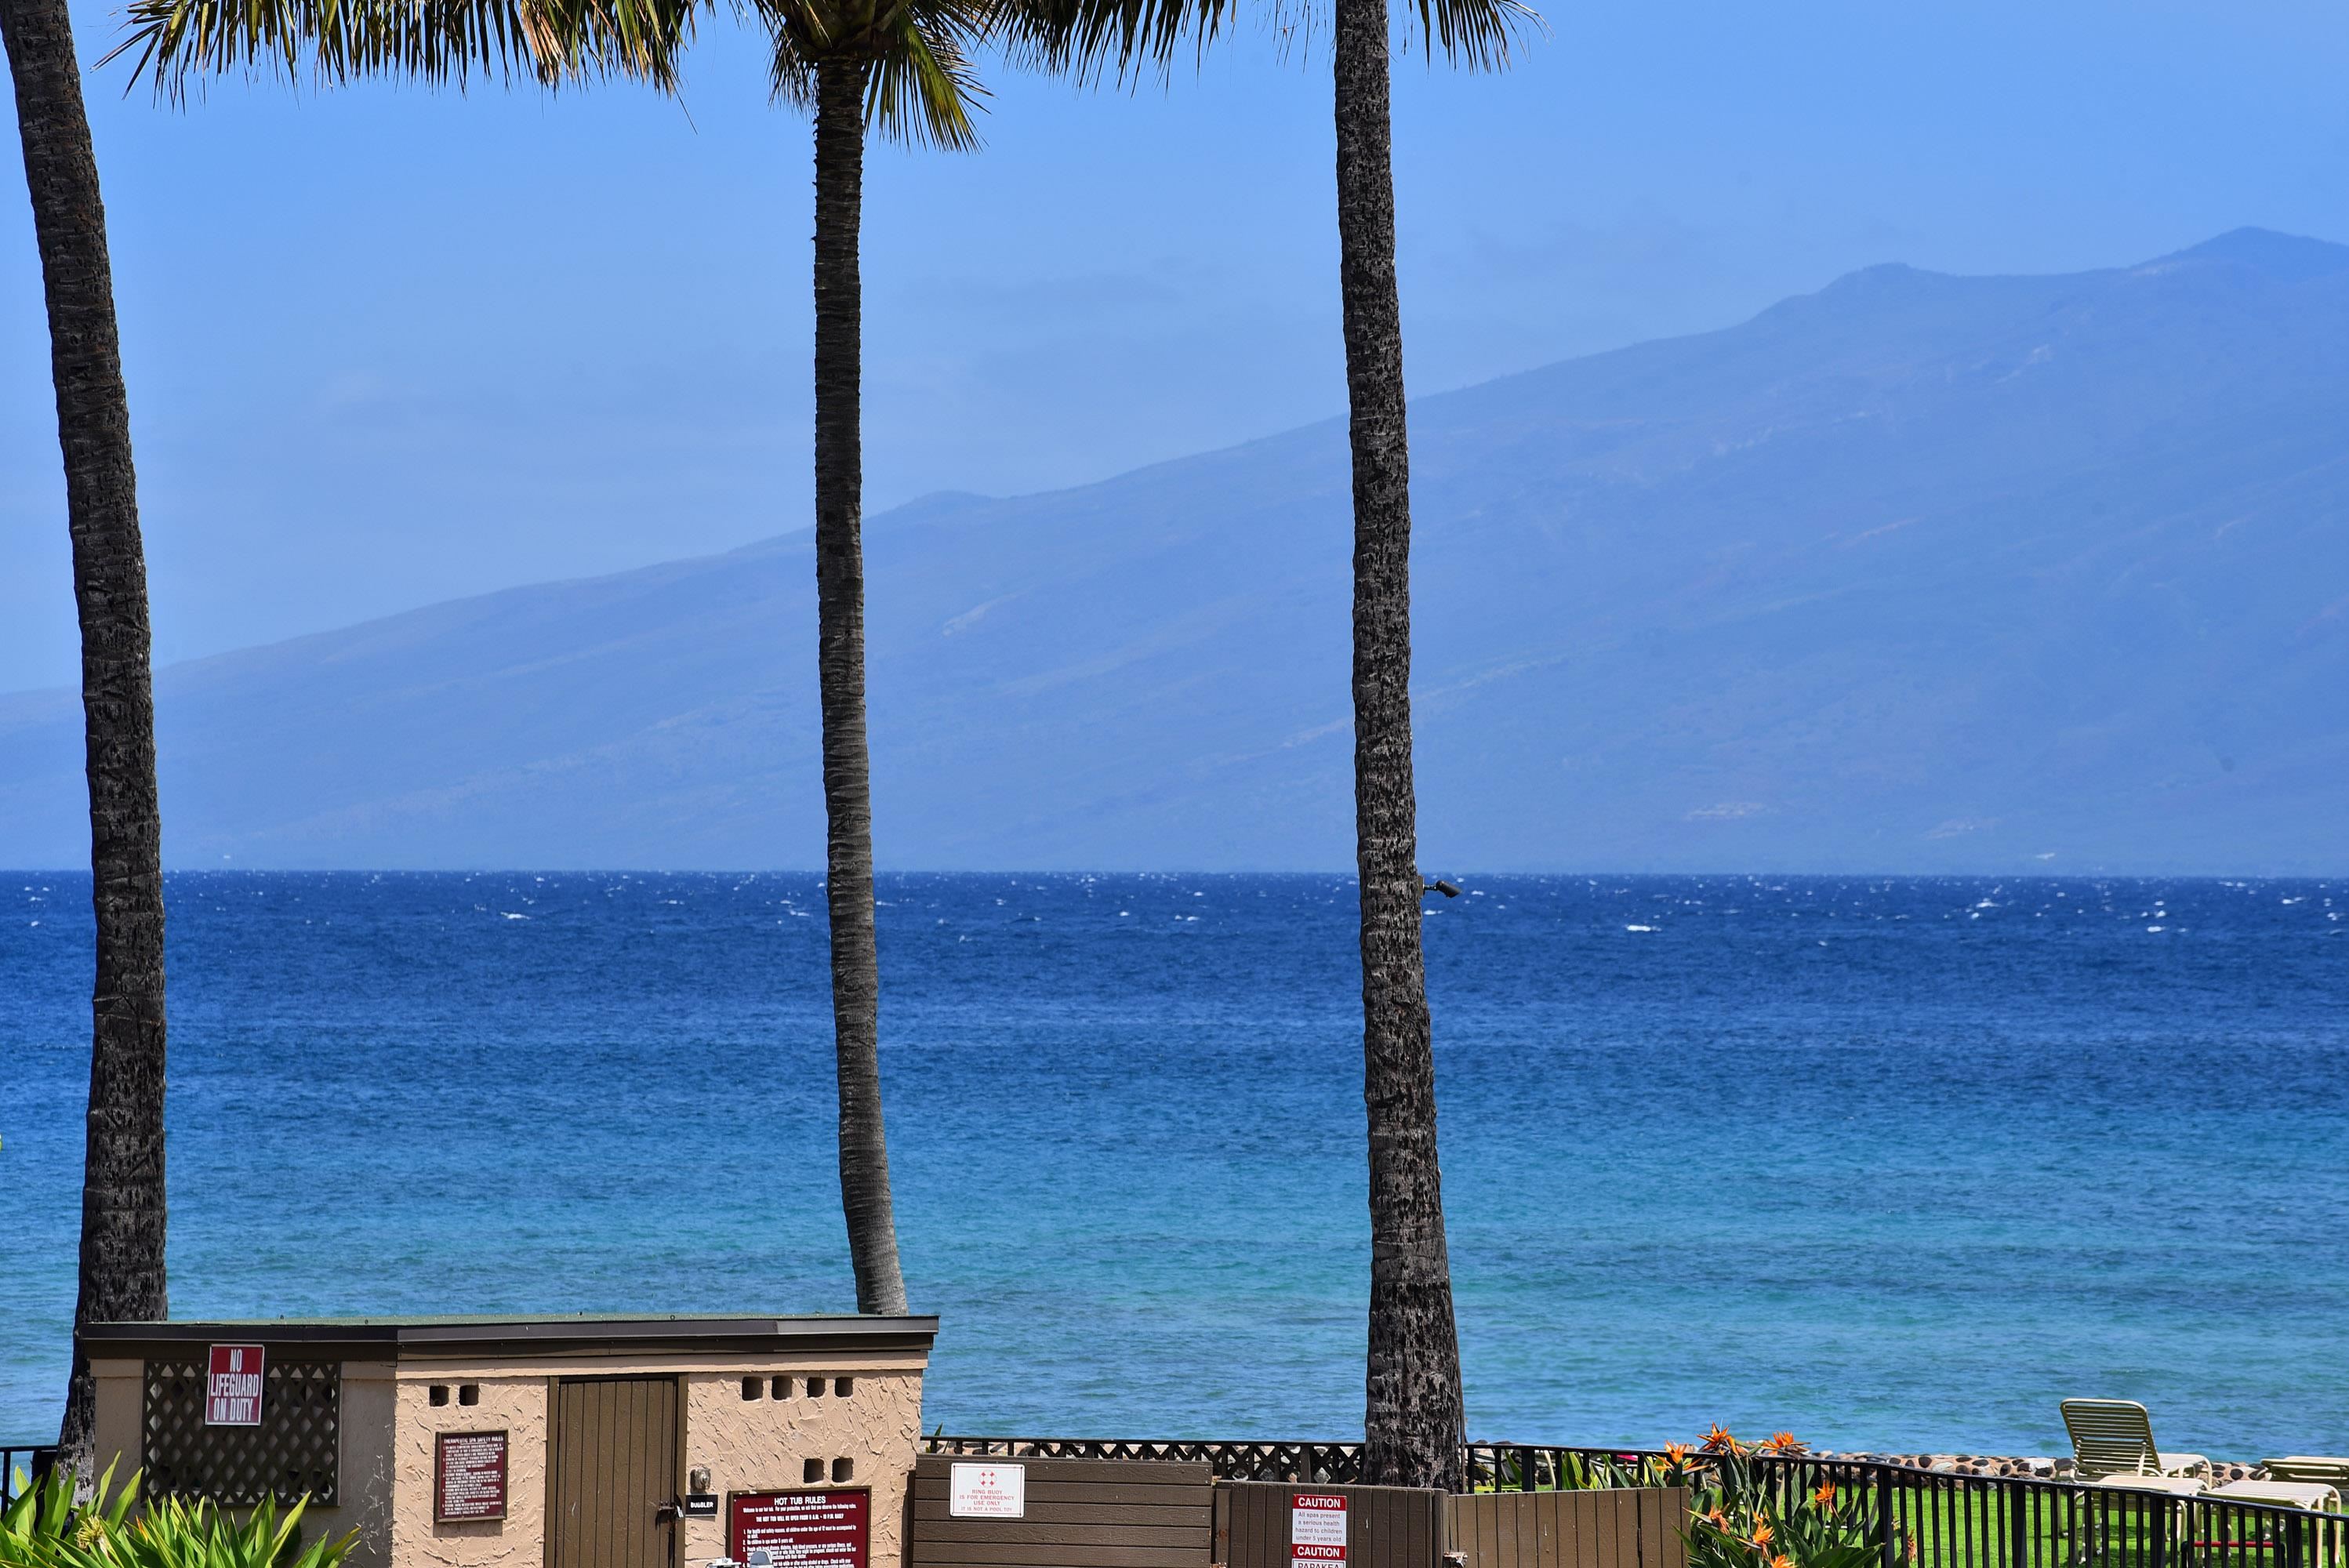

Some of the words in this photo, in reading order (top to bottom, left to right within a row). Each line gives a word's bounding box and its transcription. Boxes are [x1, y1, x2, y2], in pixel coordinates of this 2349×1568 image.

[230, 1348, 242, 1372] NO
[210, 1373, 259, 1397] LIFEGUARD
[214, 1398, 227, 1421] ON
[229, 1398, 253, 1421] DUTY
[790, 1497, 803, 1505] TUB
[805, 1496, 826, 1504] RULES
[1298, 1497, 1340, 1508] CAUTION
[1298, 1547, 1340, 1557] CAUTION
